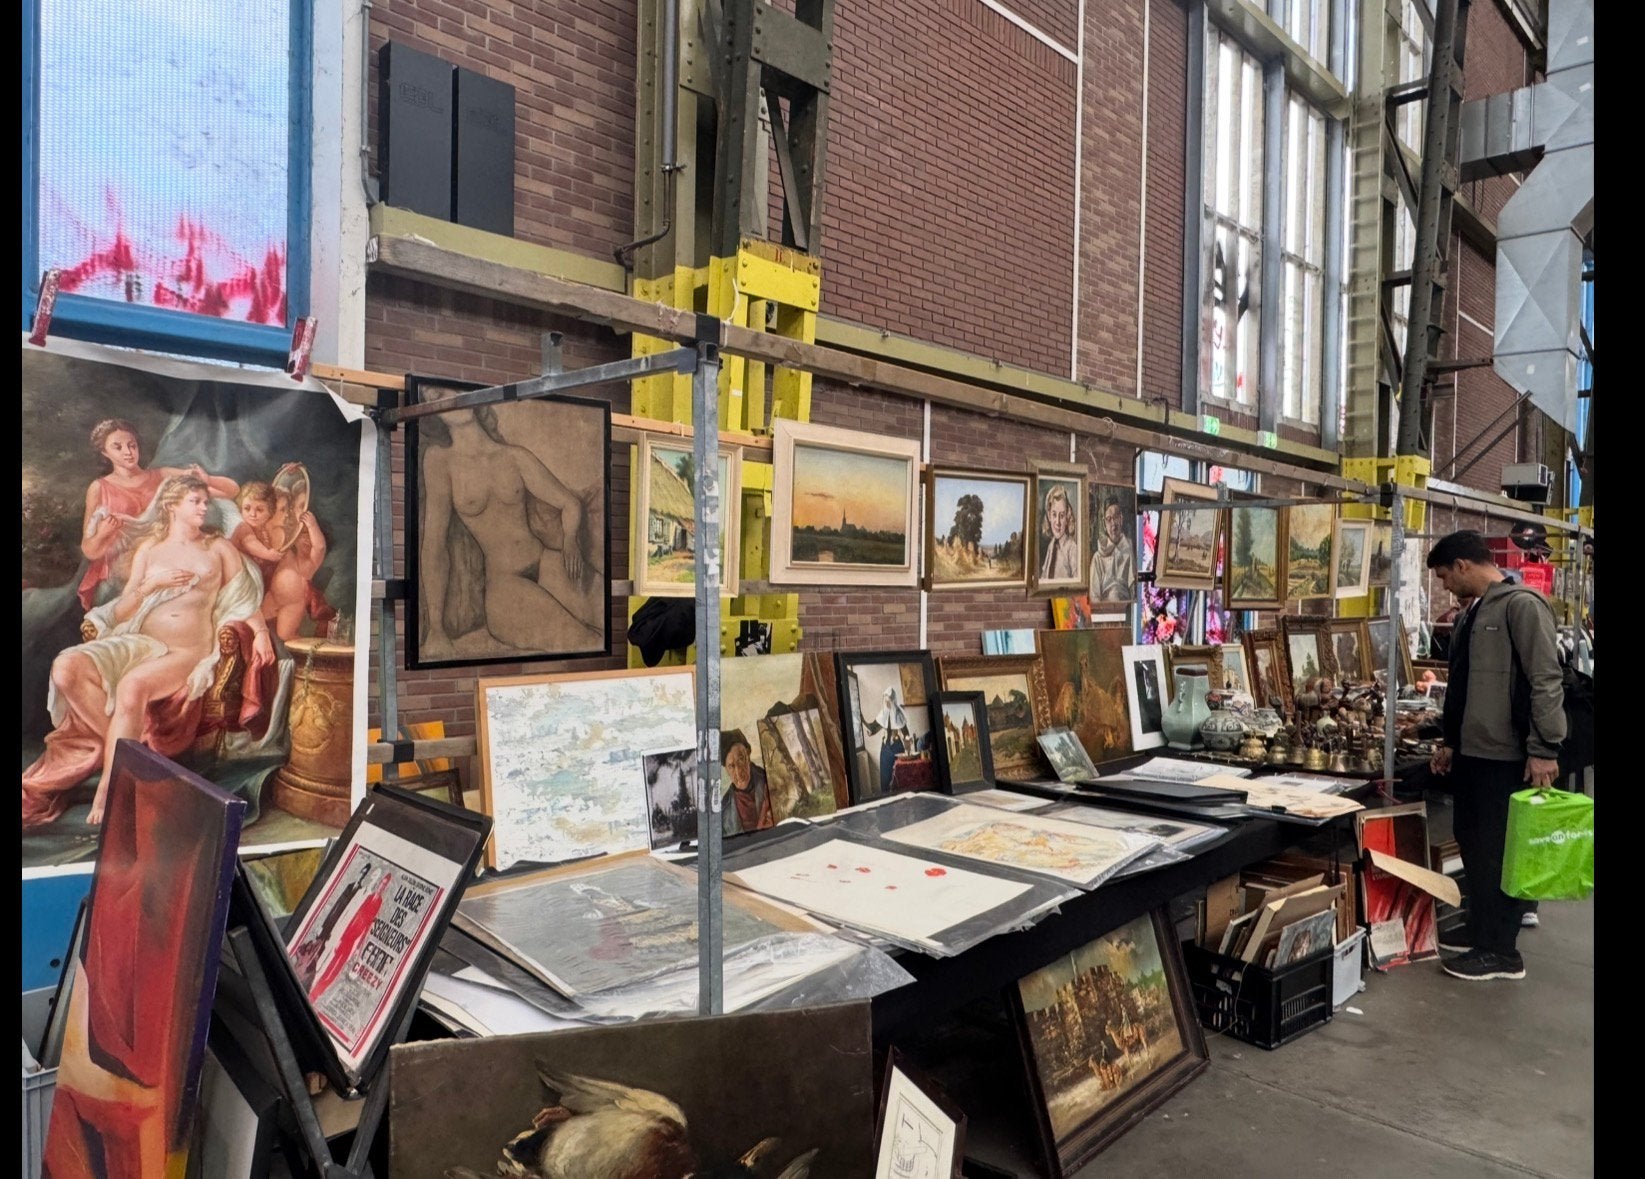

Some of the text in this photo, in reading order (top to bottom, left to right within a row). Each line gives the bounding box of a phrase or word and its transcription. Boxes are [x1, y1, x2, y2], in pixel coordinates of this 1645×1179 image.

[394, 884, 407, 904] LA
[402, 889, 425, 913] RACE
[390, 906, 408, 929] DES
[352, 961, 383, 990] CREEZY
